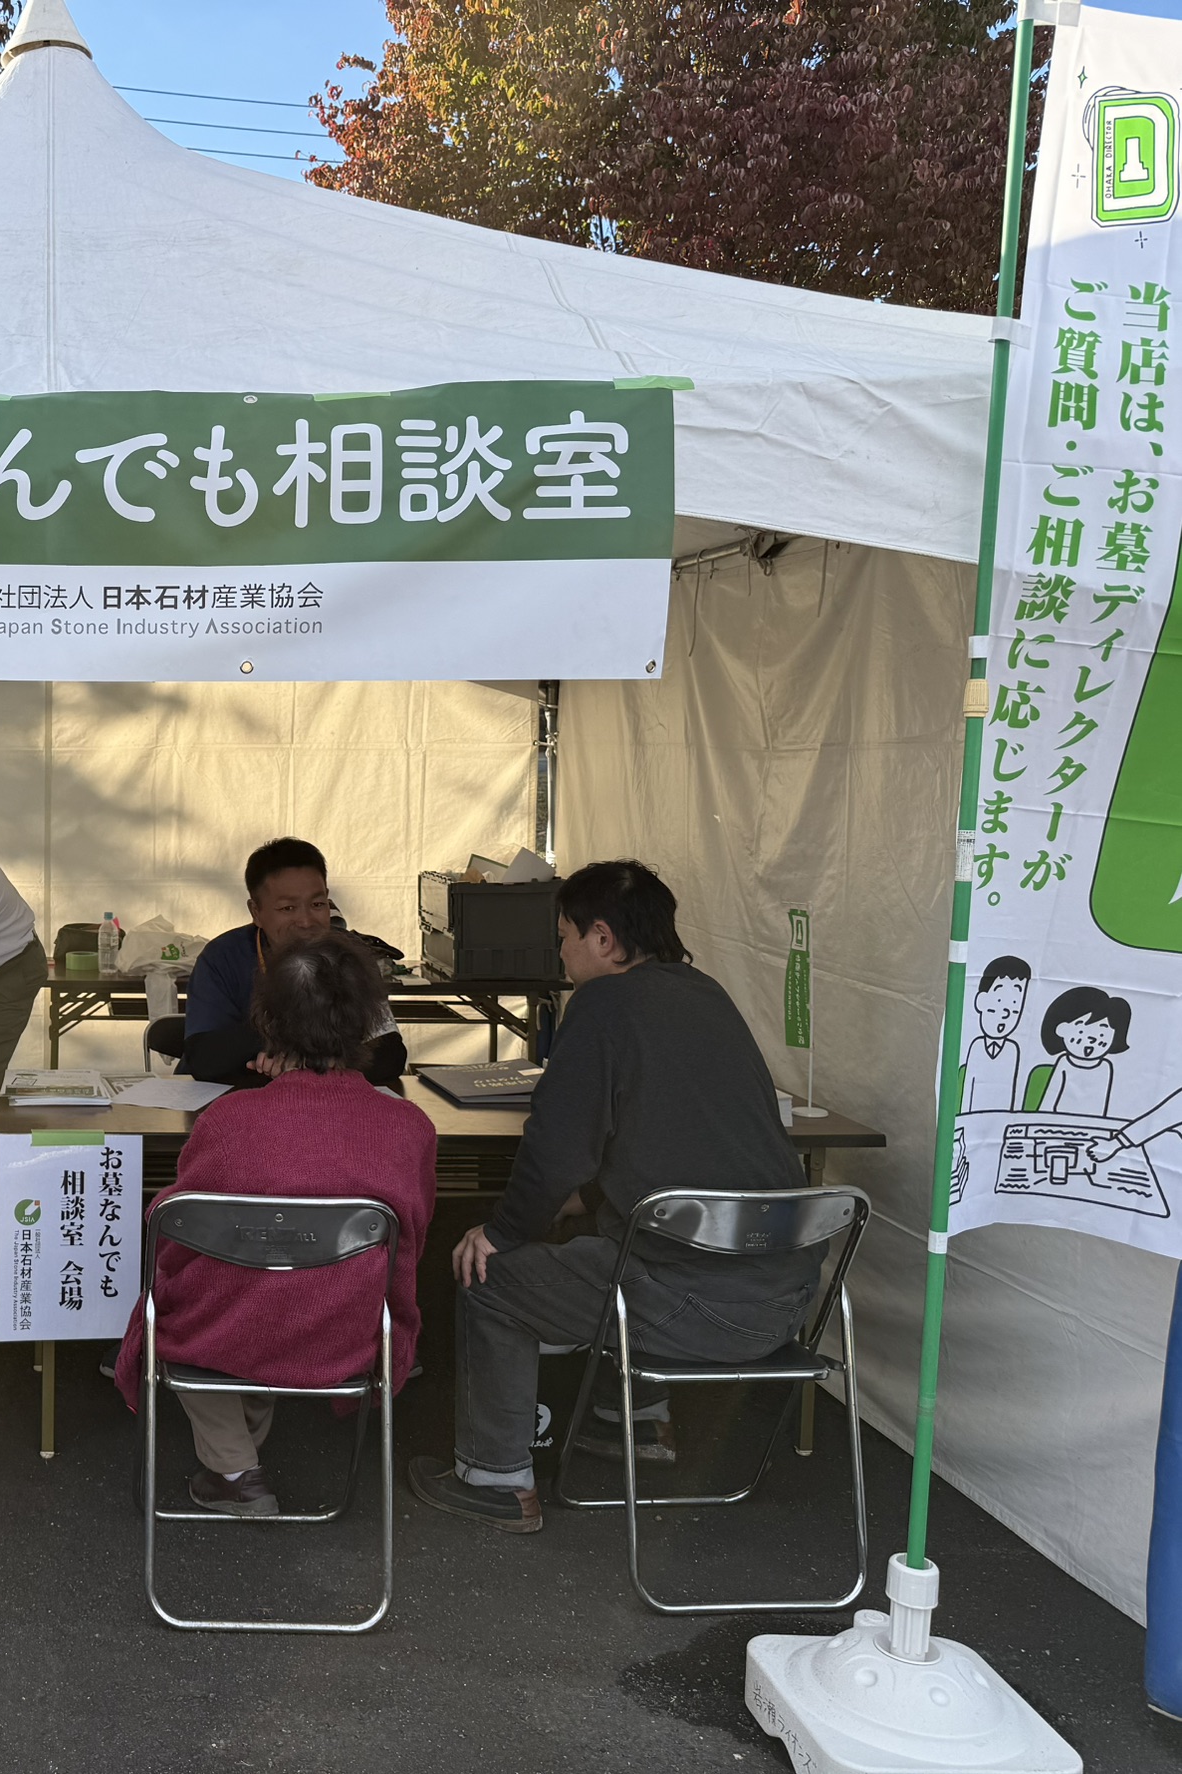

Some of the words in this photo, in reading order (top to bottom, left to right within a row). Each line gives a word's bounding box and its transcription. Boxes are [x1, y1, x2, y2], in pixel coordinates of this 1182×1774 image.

[51, 618, 109, 635] Stone
[117, 618, 199, 638] Industry
[205, 618, 322, 634] Association
[103, 581, 324, 611] 日本石材産業協会
[973, 277, 1109, 907] ご質問・ご相談に応じます。
[1020, 281, 1172, 891] 当店は、お墓ディレクターが
[60, 1170, 85, 1247] 相談室
[98, 1147, 123, 1298] お墓なんでも
[20, 1229, 32, 1331] 日本石材産業協会
[59, 1260, 85, 1311] 会場
